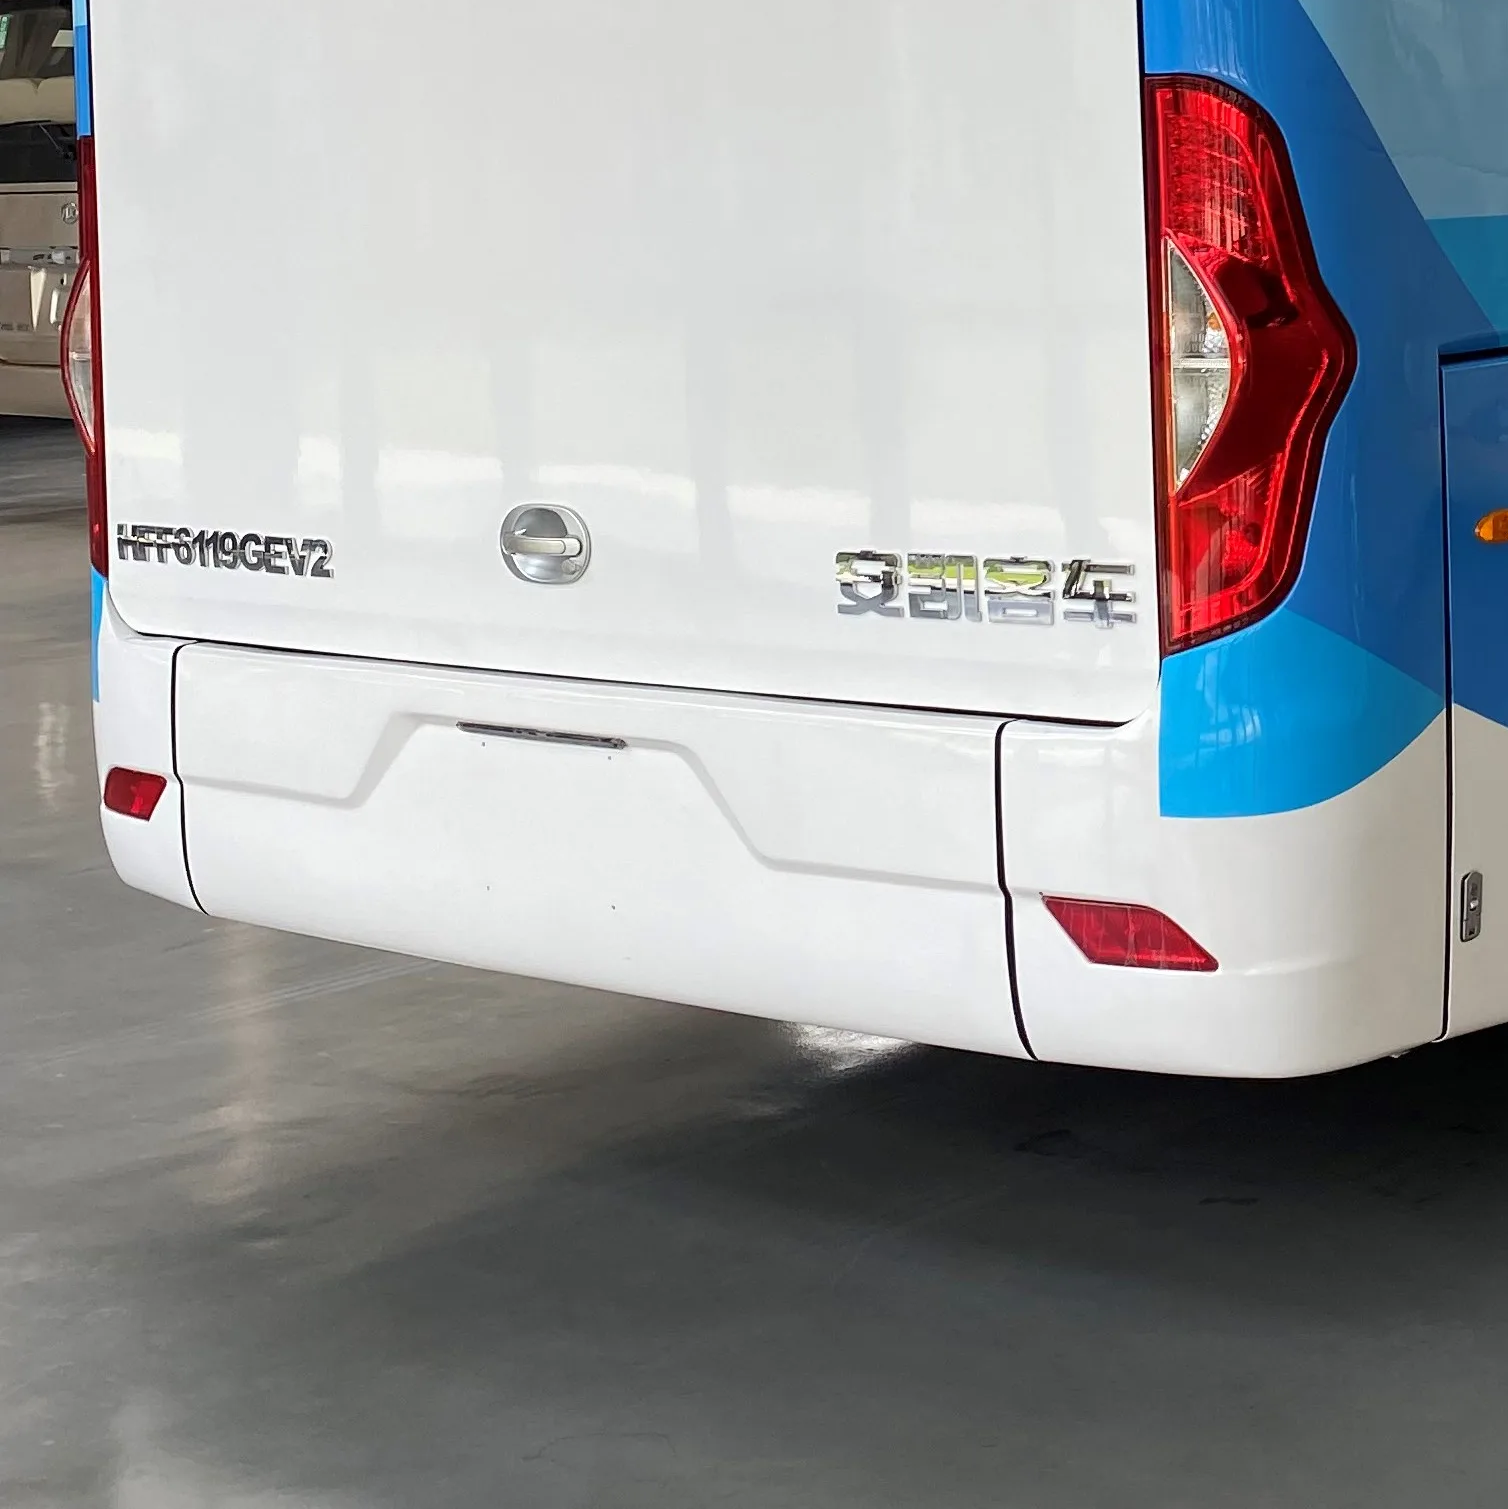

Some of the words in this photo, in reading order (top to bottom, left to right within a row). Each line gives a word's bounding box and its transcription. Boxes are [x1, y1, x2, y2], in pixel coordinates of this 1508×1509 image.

[116, 523, 335, 579] HFF6119GEV2
[835, 549, 1137, 629] 安凯客车
